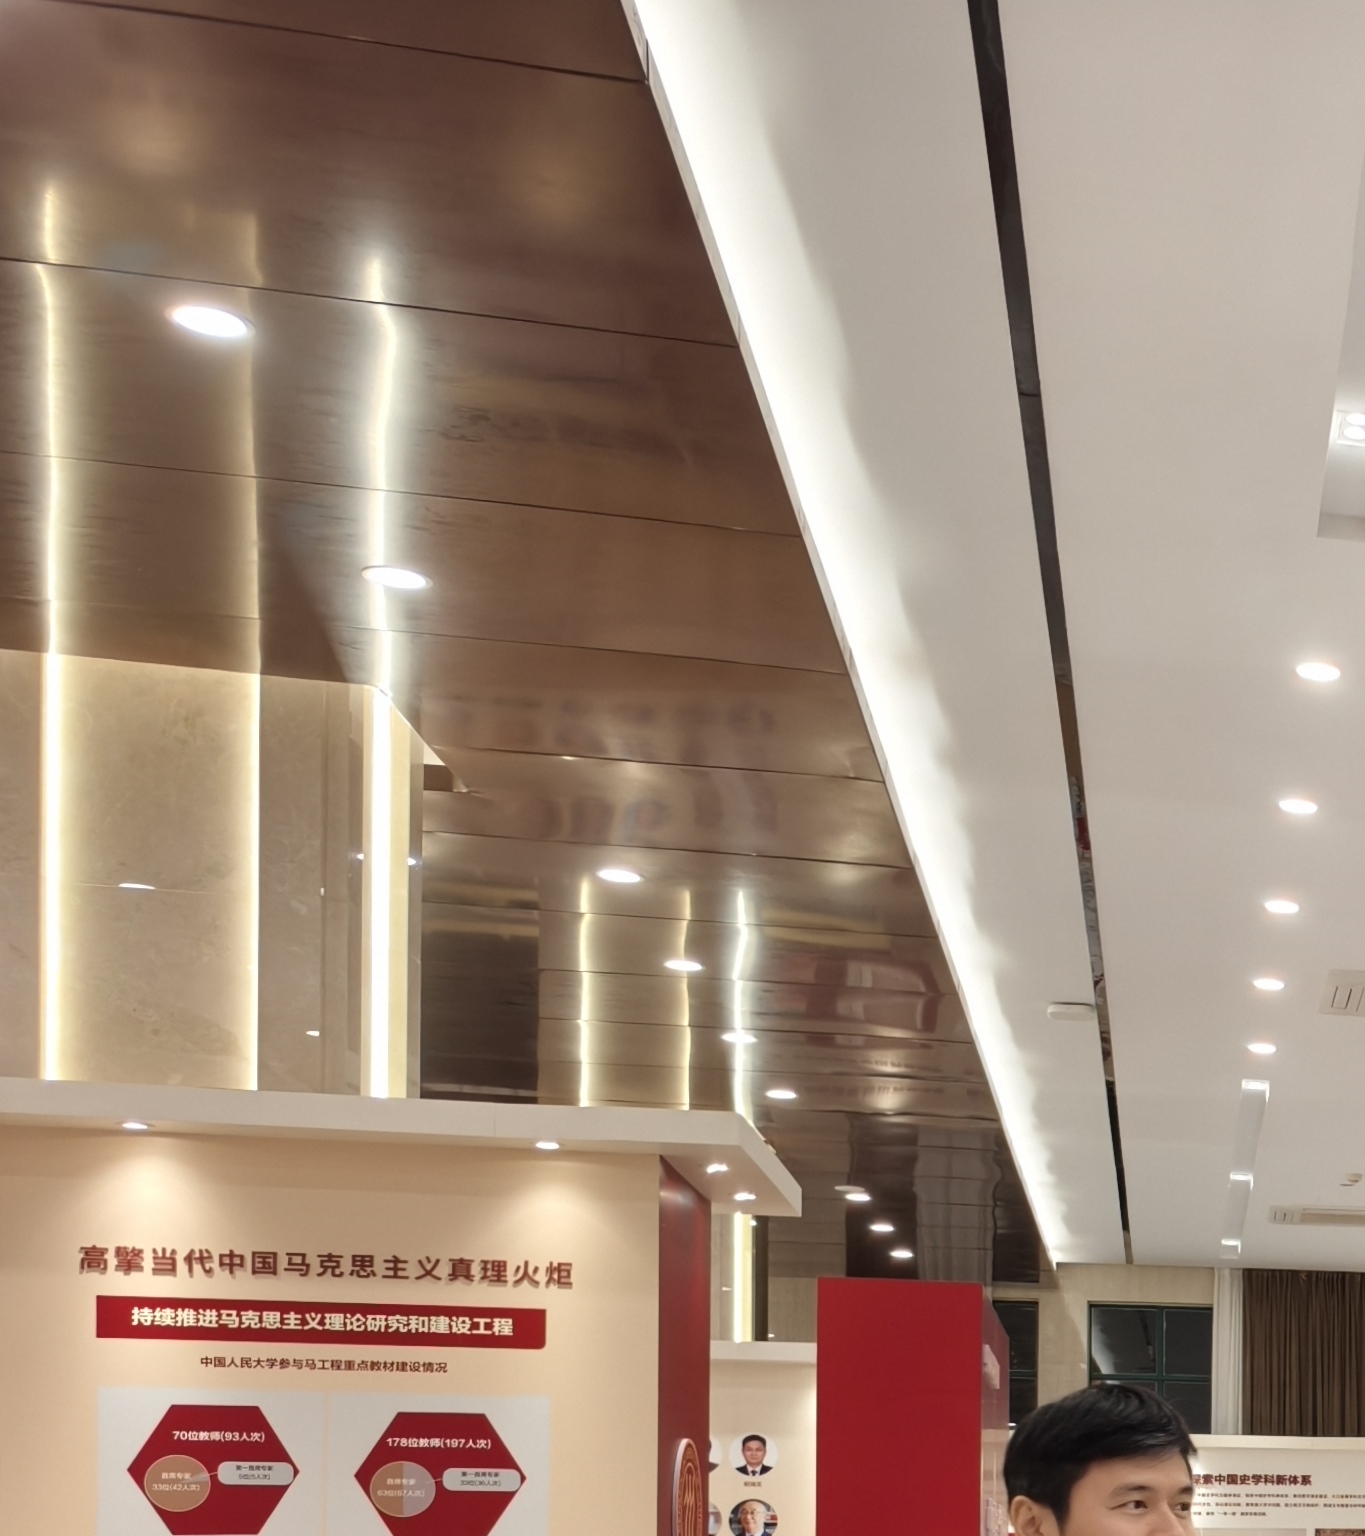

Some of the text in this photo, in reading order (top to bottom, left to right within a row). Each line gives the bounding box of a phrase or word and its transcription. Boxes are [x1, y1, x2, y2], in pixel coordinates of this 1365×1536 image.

[78, 1244, 573, 1287] 高擎当代中国马克思主义真理火炬
[131, 1307, 514, 1336] 持续推进马克思主义理论研究和建设工程
[200, 1356, 448, 1374] 中国人民大学参与马工程重点教材建设情况
[172, 1431, 265, 1443] 70位教师(93人次)
[386, 1438, 491, 1449] 178位教师(197人次)
